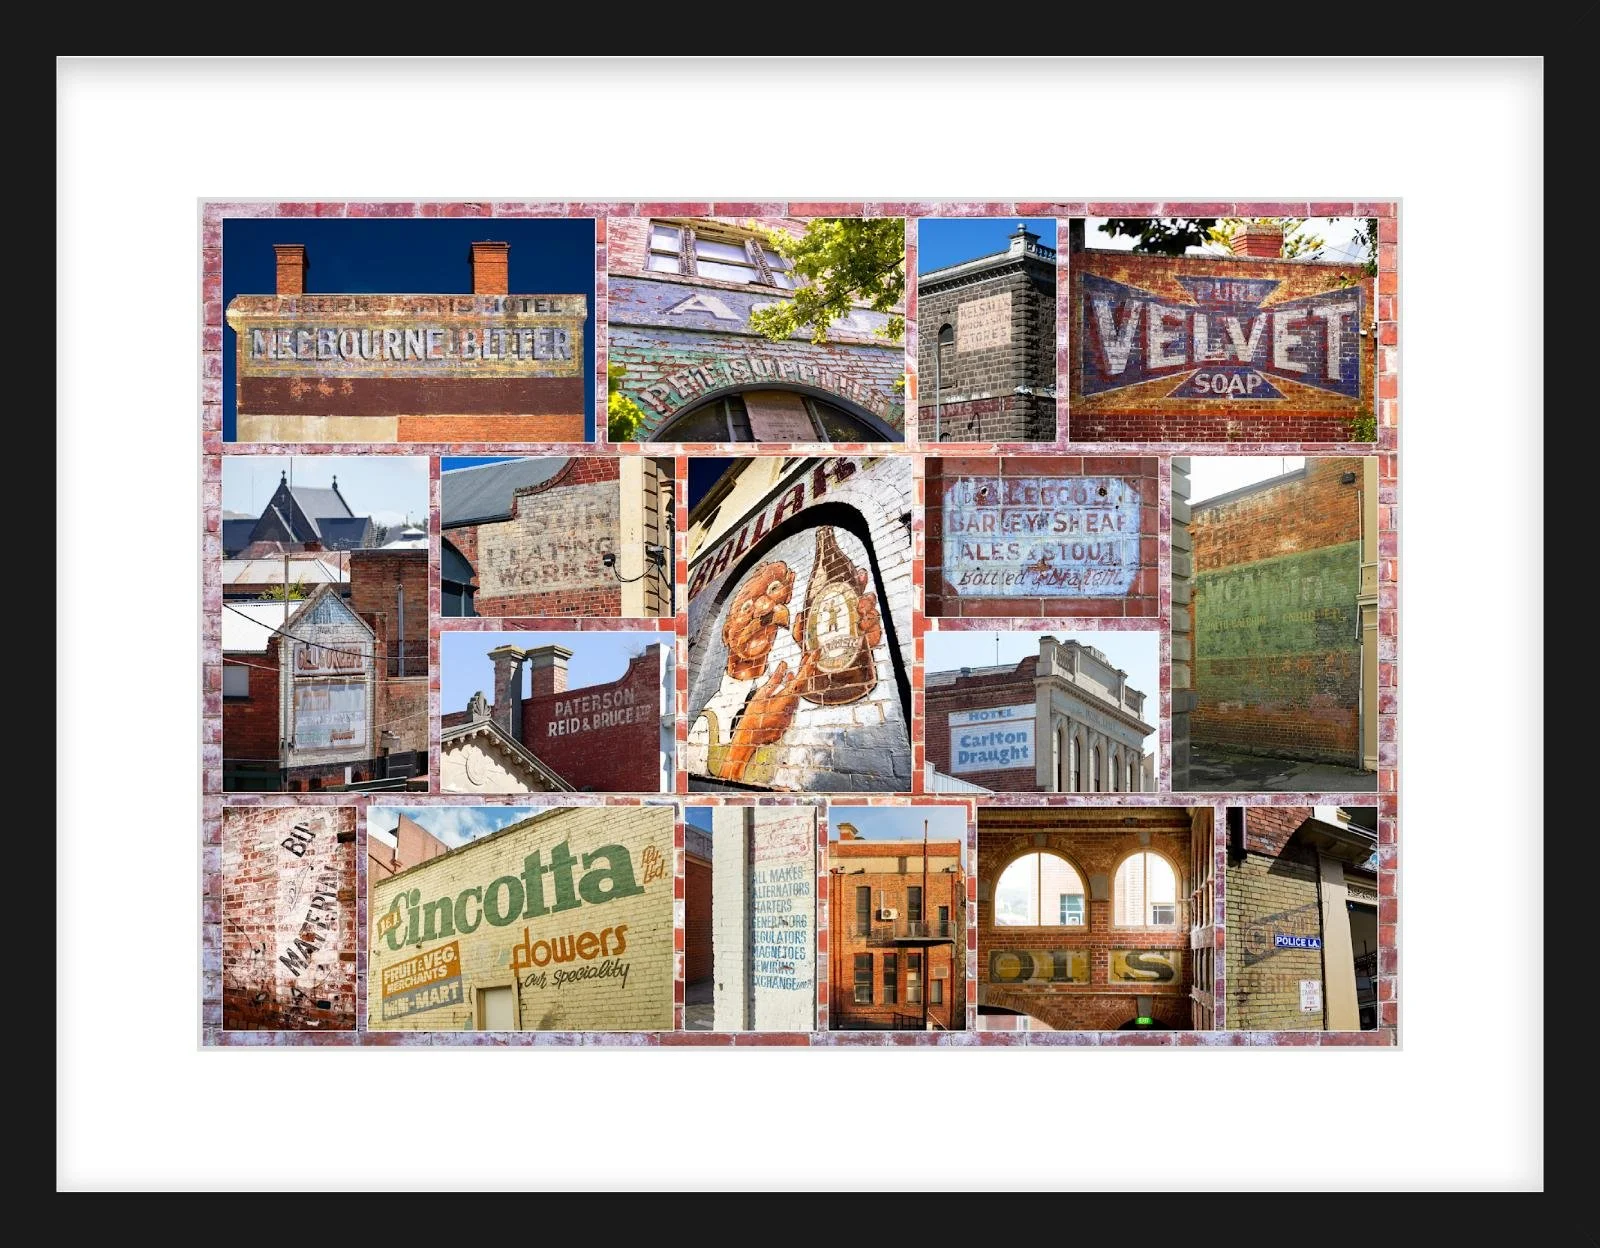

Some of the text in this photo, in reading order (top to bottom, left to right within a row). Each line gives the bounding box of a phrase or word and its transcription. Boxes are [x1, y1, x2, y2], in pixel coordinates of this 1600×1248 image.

[1090, 300, 1357, 380] VELVET
[639, 363, 717, 415] PET
[1194, 373, 1263, 393] SOAP
[950, 511, 1038, 533] BARLEY
[962, 544, 1019, 561] ALES
[555, 688, 634, 716] PATERSON
[549, 718, 580, 737] REID
[582, 718, 591, 731] &
[593, 707, 633, 729] BRUCE
[968, 708, 1014, 721] HOTEL
[960, 730, 1027, 748] Carlton
[958, 746, 1028, 765] Draught
[770, 866, 804, 883] MAKES
[386, 839, 646, 951] Cincotta
[752, 882, 809, 899] ALTERNATORS
[1276, 936, 1306, 947] POLICE
[384, 959, 416, 984] FRUIT
[387, 965, 447, 994] MERCHANTS
[524, 971, 547, 989] our
